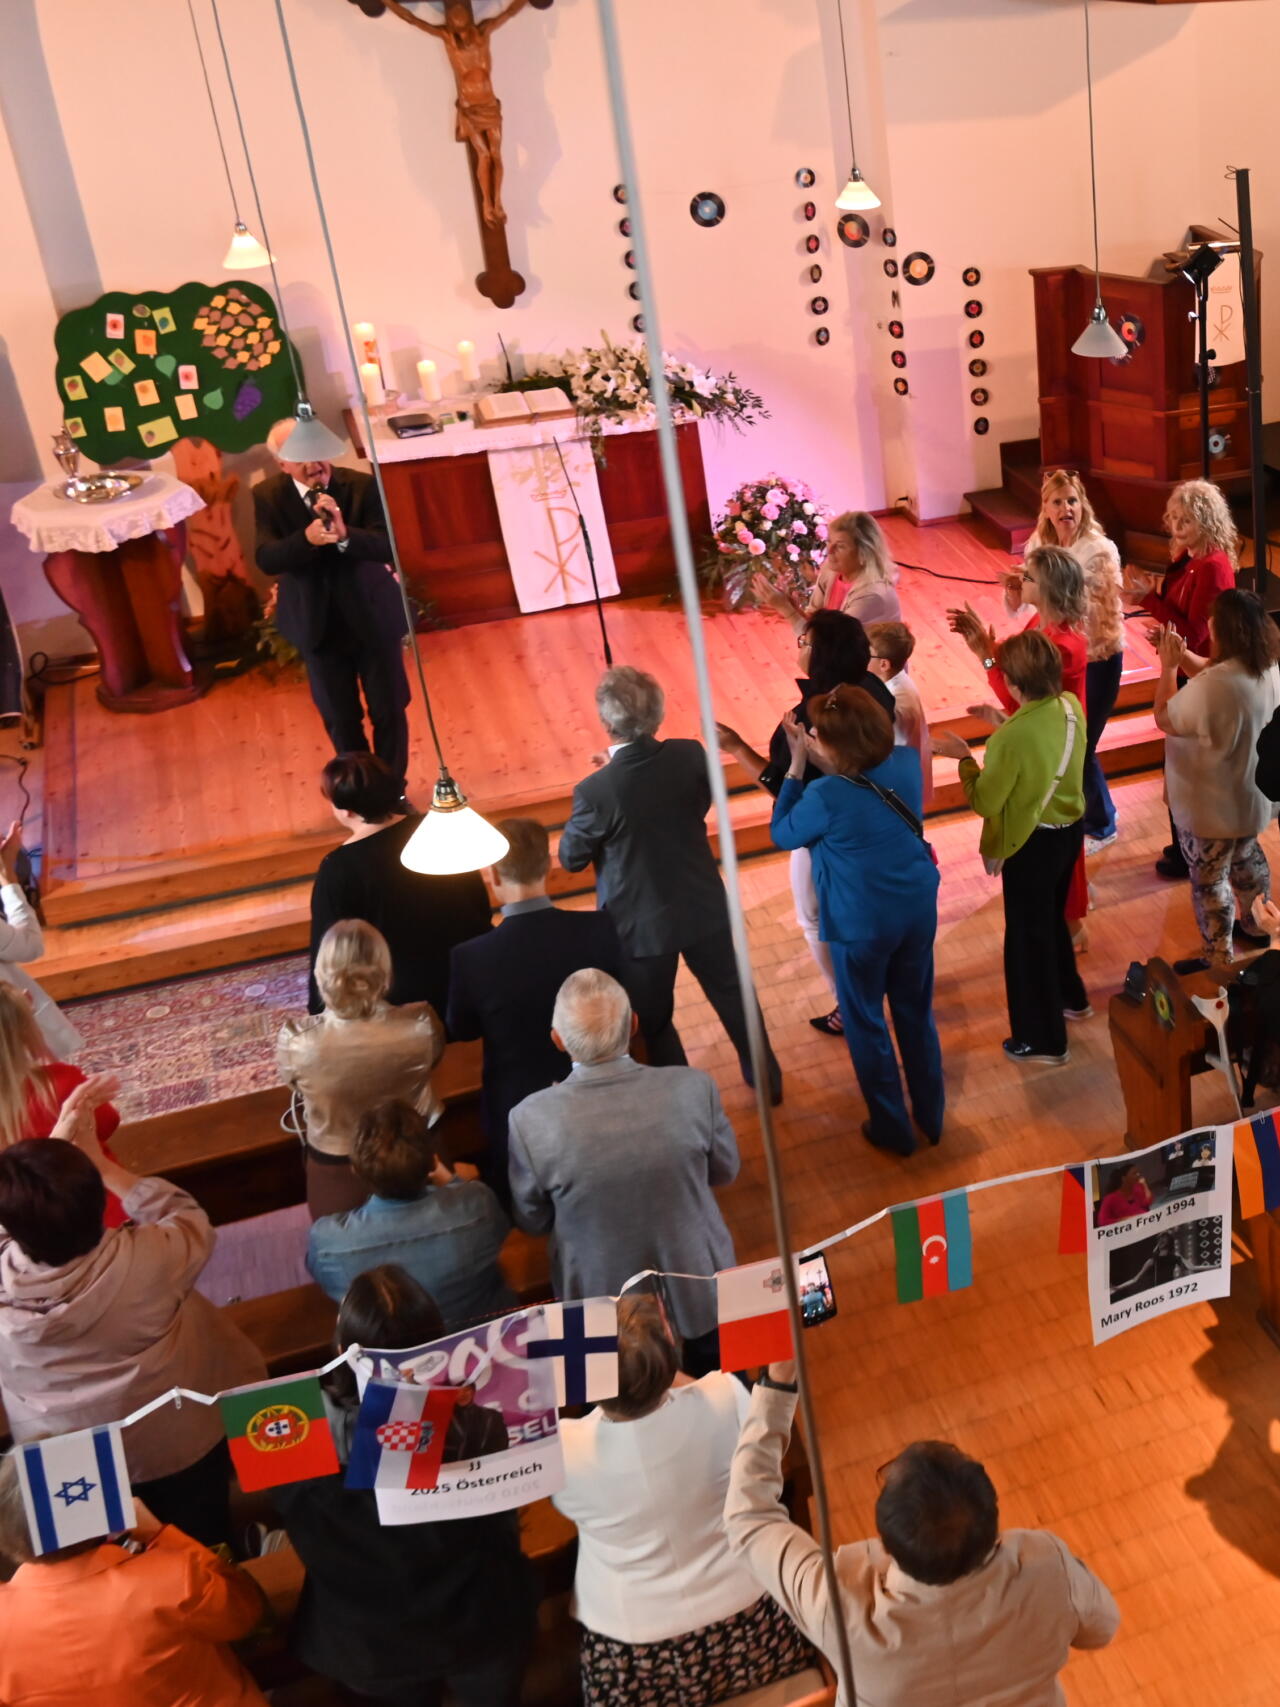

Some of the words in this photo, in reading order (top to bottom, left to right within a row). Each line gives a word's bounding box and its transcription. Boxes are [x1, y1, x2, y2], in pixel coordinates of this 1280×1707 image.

[1097, 1222, 1132, 1240] Petra
[1136, 1210, 1163, 1227] Frey
[1166, 1197, 1196, 1216] 1994
[1100, 1308, 1132, 1328] Mary
[1135, 1294, 1165, 1311] Roos
[1168, 1282, 1198, 1299] 1972
[456, 1462, 543, 1491] Österreich
